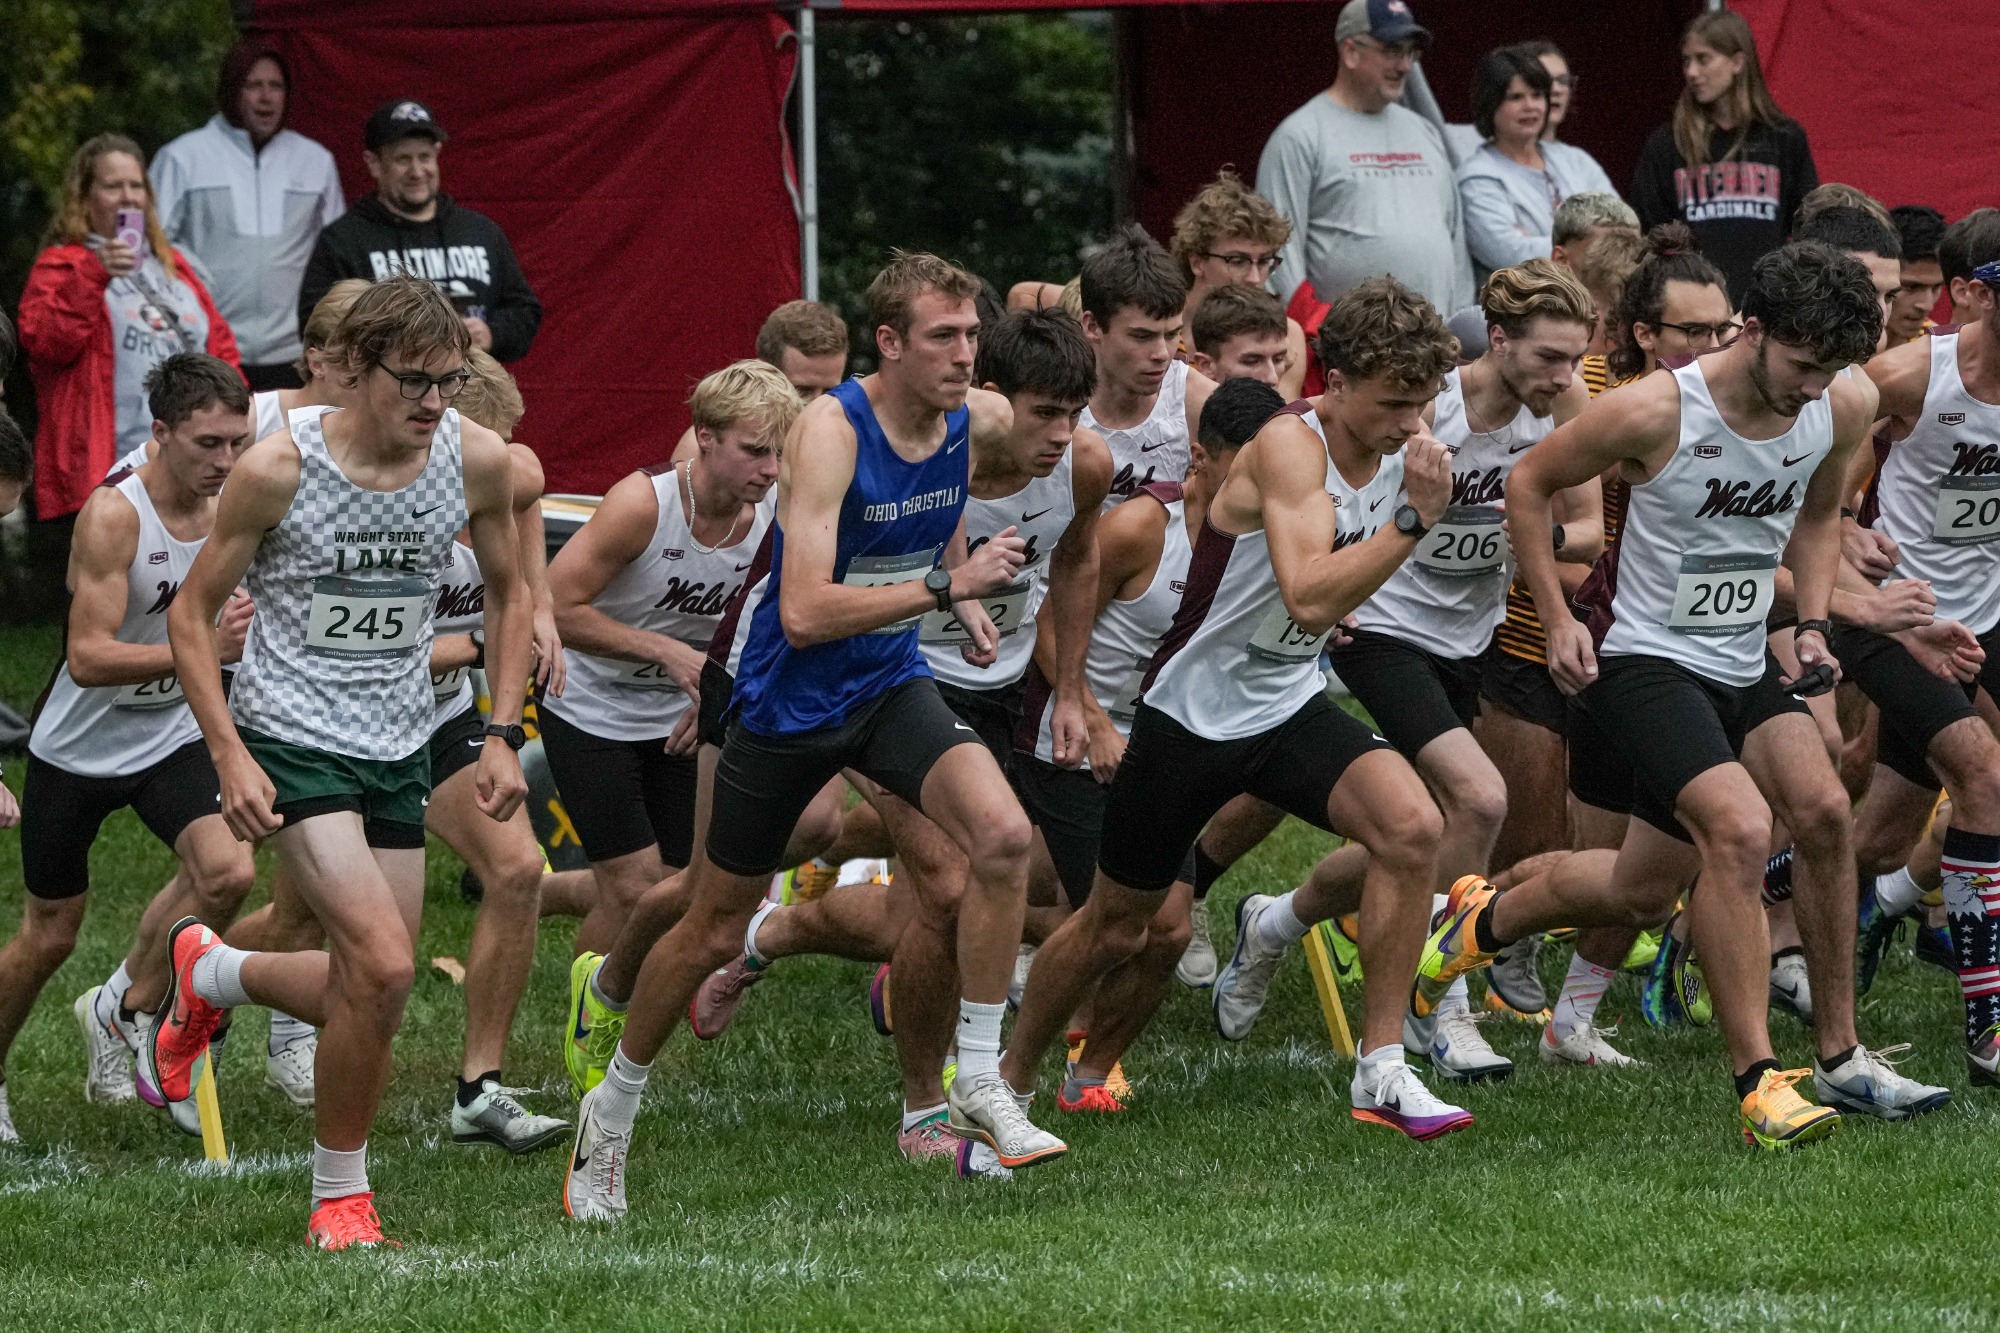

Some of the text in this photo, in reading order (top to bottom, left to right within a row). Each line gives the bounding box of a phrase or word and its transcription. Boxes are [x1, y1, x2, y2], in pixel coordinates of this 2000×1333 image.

[1686, 201, 1777, 221] CARDINALS
[369, 245, 491, 285] BALTIMORE
[1448, 466, 1505, 506] Wals
[1695, 478, 1798, 519] Walsh
[863, 502, 898, 522] OHIO
[1952, 497, 2000, 528] 20
[334, 531, 426, 543] WRIGHT STATE
[1431, 531, 1501, 561] 206
[336, 548, 421, 573] LAKE
[1688, 579, 1757, 616] 209
[325, 606, 405, 640] 245
